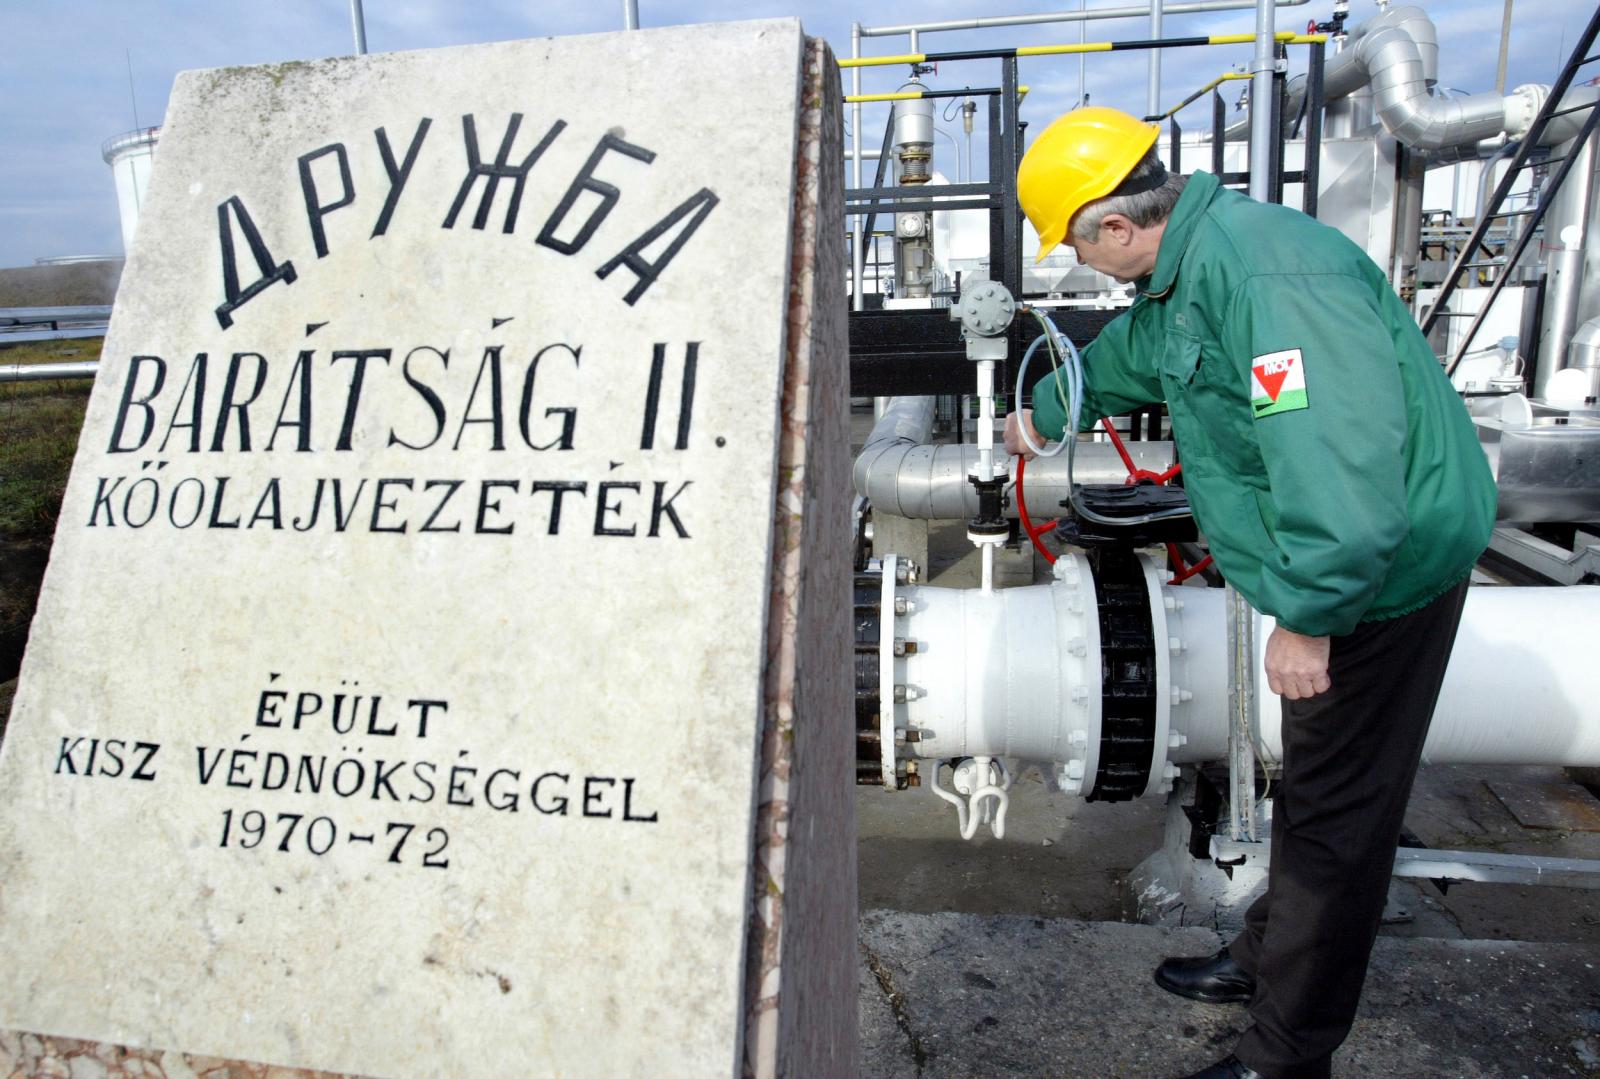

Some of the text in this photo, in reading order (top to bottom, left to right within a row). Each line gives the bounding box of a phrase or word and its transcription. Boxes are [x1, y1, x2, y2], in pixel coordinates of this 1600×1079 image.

[215, 113, 719, 331] ДРУЖБА
[106, 317, 584, 455] BARÁTSÁG
[1263, 359, 1291, 377] MOL
[87, 460, 696, 539] KŐOLAJVEZETÉK
[255, 673, 449, 739] ÉPÜLT
[55, 733, 660, 823] KISZ VÉDNÖKSÉGGEL
[218, 808, 451, 869] 1970-72
